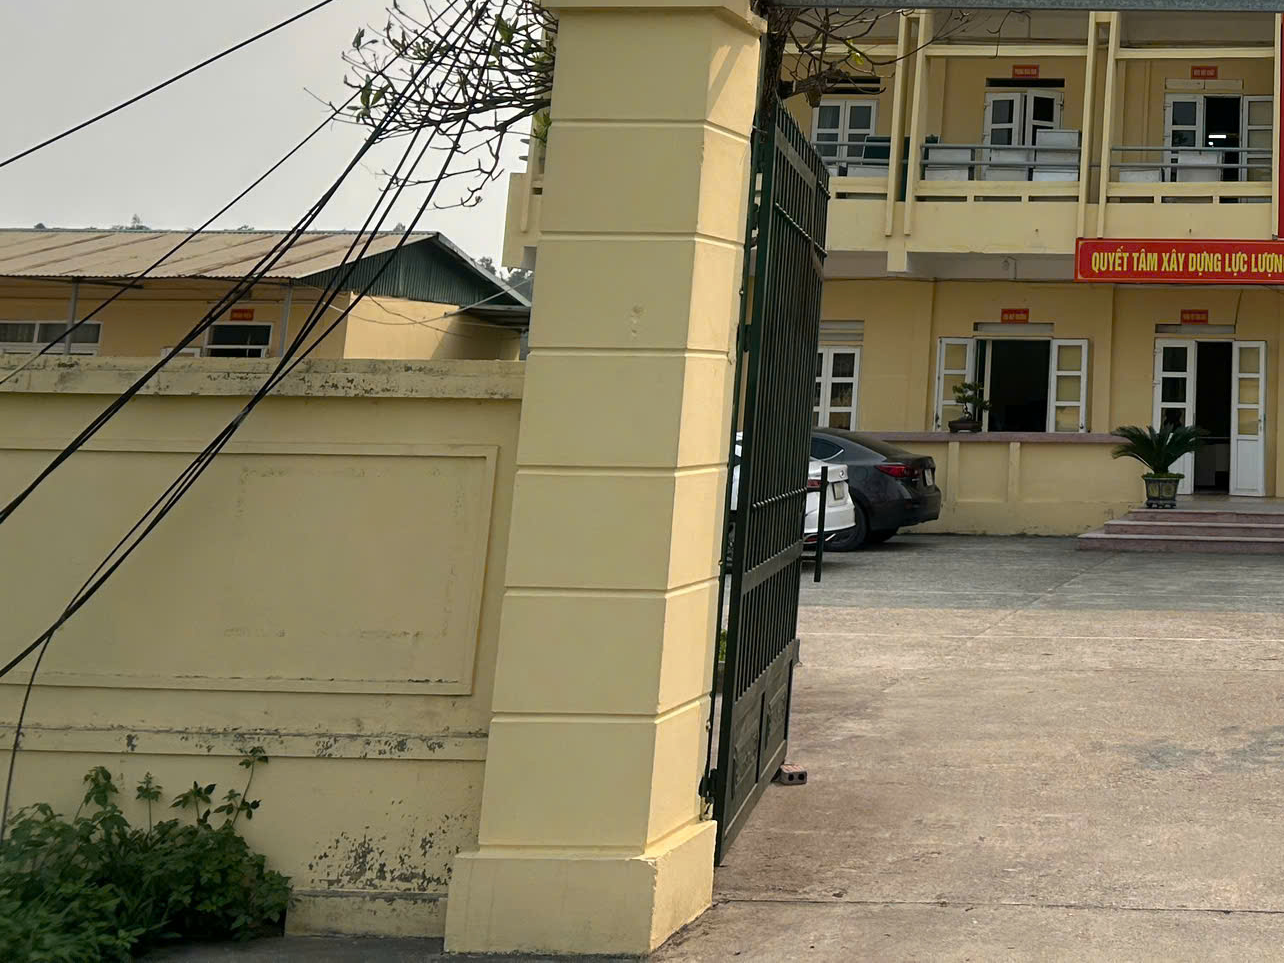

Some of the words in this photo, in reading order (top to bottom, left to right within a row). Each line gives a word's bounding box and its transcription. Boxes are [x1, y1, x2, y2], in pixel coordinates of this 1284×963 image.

[1091, 245, 1129, 273] QUYẾT
[1132, 248, 1158, 272] TÂM
[1161, 248, 1185, 272] XÂY
[1188, 251, 1222, 276] DỰNG
[1225, 251, 1248, 276] LỰC
